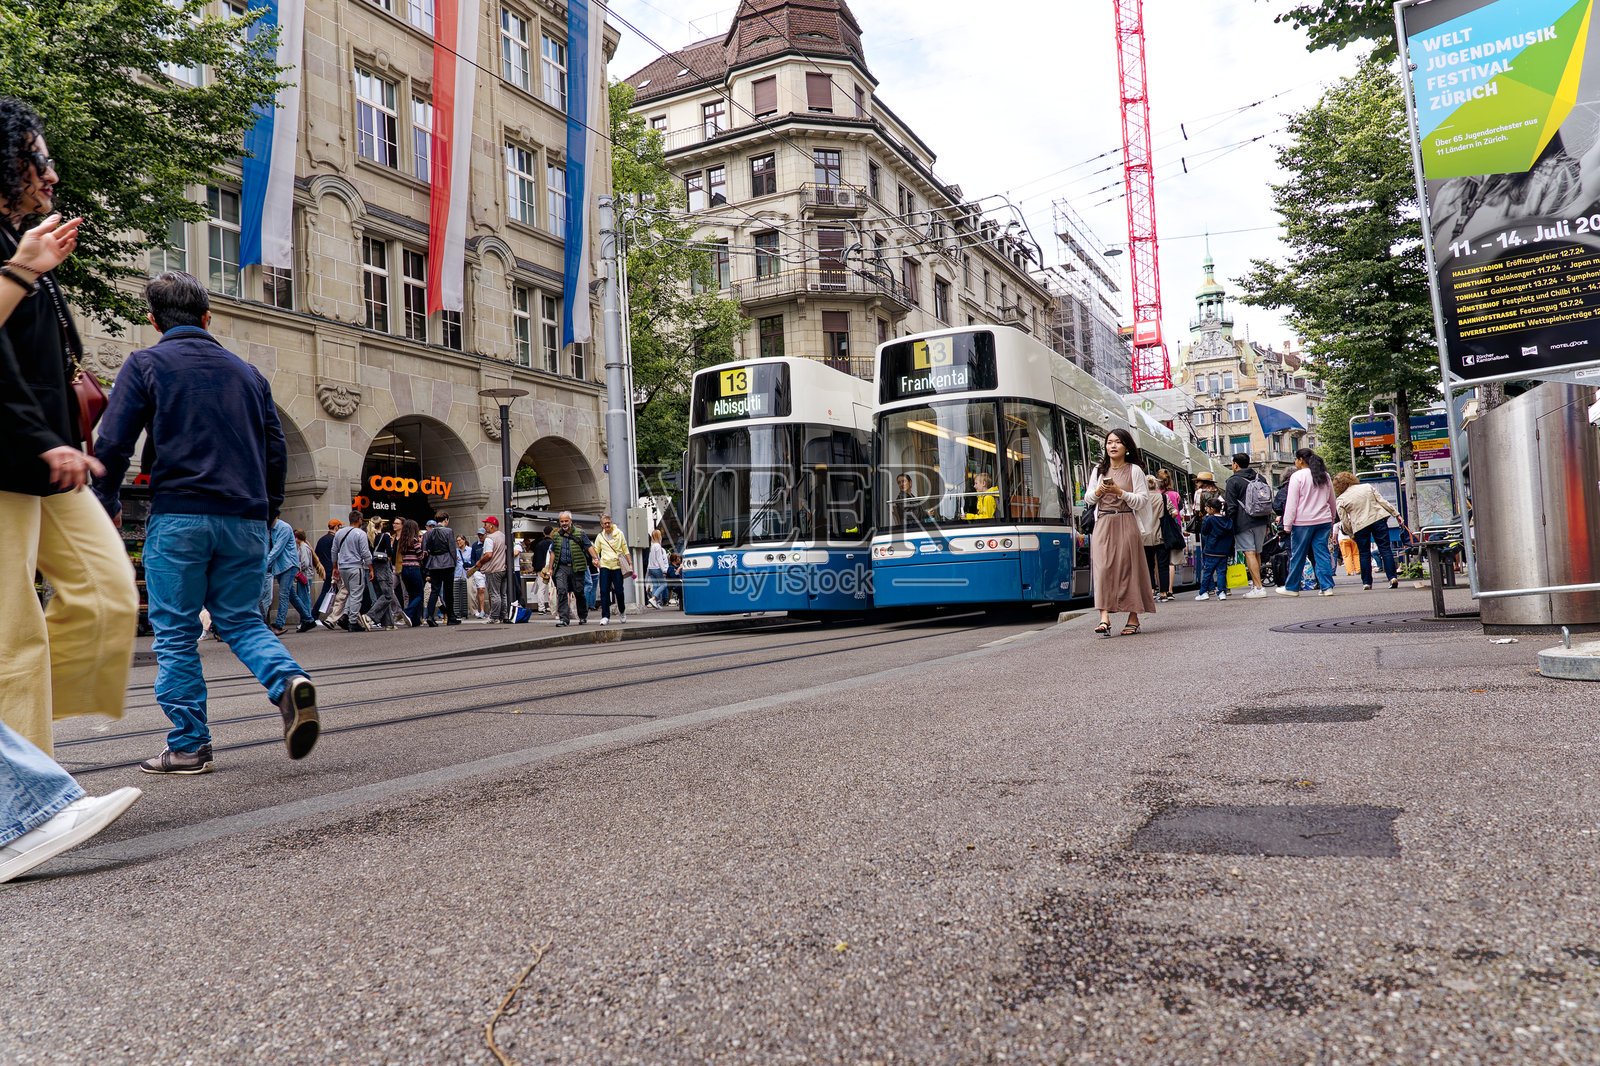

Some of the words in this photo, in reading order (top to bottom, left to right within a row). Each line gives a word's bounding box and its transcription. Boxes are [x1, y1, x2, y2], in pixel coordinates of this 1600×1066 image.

[1422, 27, 1472, 52] WELT
[1426, 25, 1557, 72] JUGENDMUSIK
[1427, 58, 1514, 91] FESTIVAL
[1429, 81, 1498, 110] ZÜRICH
[1435, 137, 1451, 148] Über
[1453, 134, 1463, 142] 65
[1464, 120, 1523, 140] Jugendorchester
[1524, 118, 1538, 126] aus
[1436, 148, 1445, 156] 11
[1446, 142, 1474, 154] Ländern
[1475, 140, 1482, 148] in
[1483, 134, 1509, 146] Zürich.
[1448, 240, 1477, 258] 11.
[1496, 230, 1528, 248] 14.
[1532, 220, 1571, 242] Juli
[1575, 214, 1600, 235] 20
[1452, 262, 1503, 278] HALLENSTADION
[1506, 252, 1559, 268] Eröffnungsfeier
[1560, 247, 1585, 258] 12.7.24
[1454, 277, 1492, 290] KUNSTHAUS
[1494, 268, 1536, 282] Galakonzert
[1538, 264, 1561, 274] 11.7.24
[1570, 260, 1592, 269] Japan
[1455, 290, 1488, 302] TONHALLE
[1490, 283, 1532, 295] Galakonzert
[1533, 278, 1558, 288] 13.7.24
[1456, 300, 1500, 314] MÜNSTERHOF
[1502, 294, 1535, 306] Festplatz
[1536, 292, 1550, 300] und
[1550, 287, 1570, 298] Chilbi
[1572, 286, 1582, 294] 11.
[1458, 310, 1518, 326] BAHNHOFSTRASSE
[1520, 304, 1558, 315] Festumzug
[1558, 298, 1584, 308] 13.7.24
[1460, 328, 1486, 338] DIVERSE
[1487, 322, 1526, 333] STANDORTE
[1527, 310, 1592, 326] Wettspielvorträge
[921, 342, 947, 365] 13
[726, 372, 748, 392] 13
[901, 368, 969, 392] Frankental
[370, 474, 418, 497] coop
[420, 476, 452, 500] city
[372, 500, 390, 510] take
[391, 502, 397, 510] it
